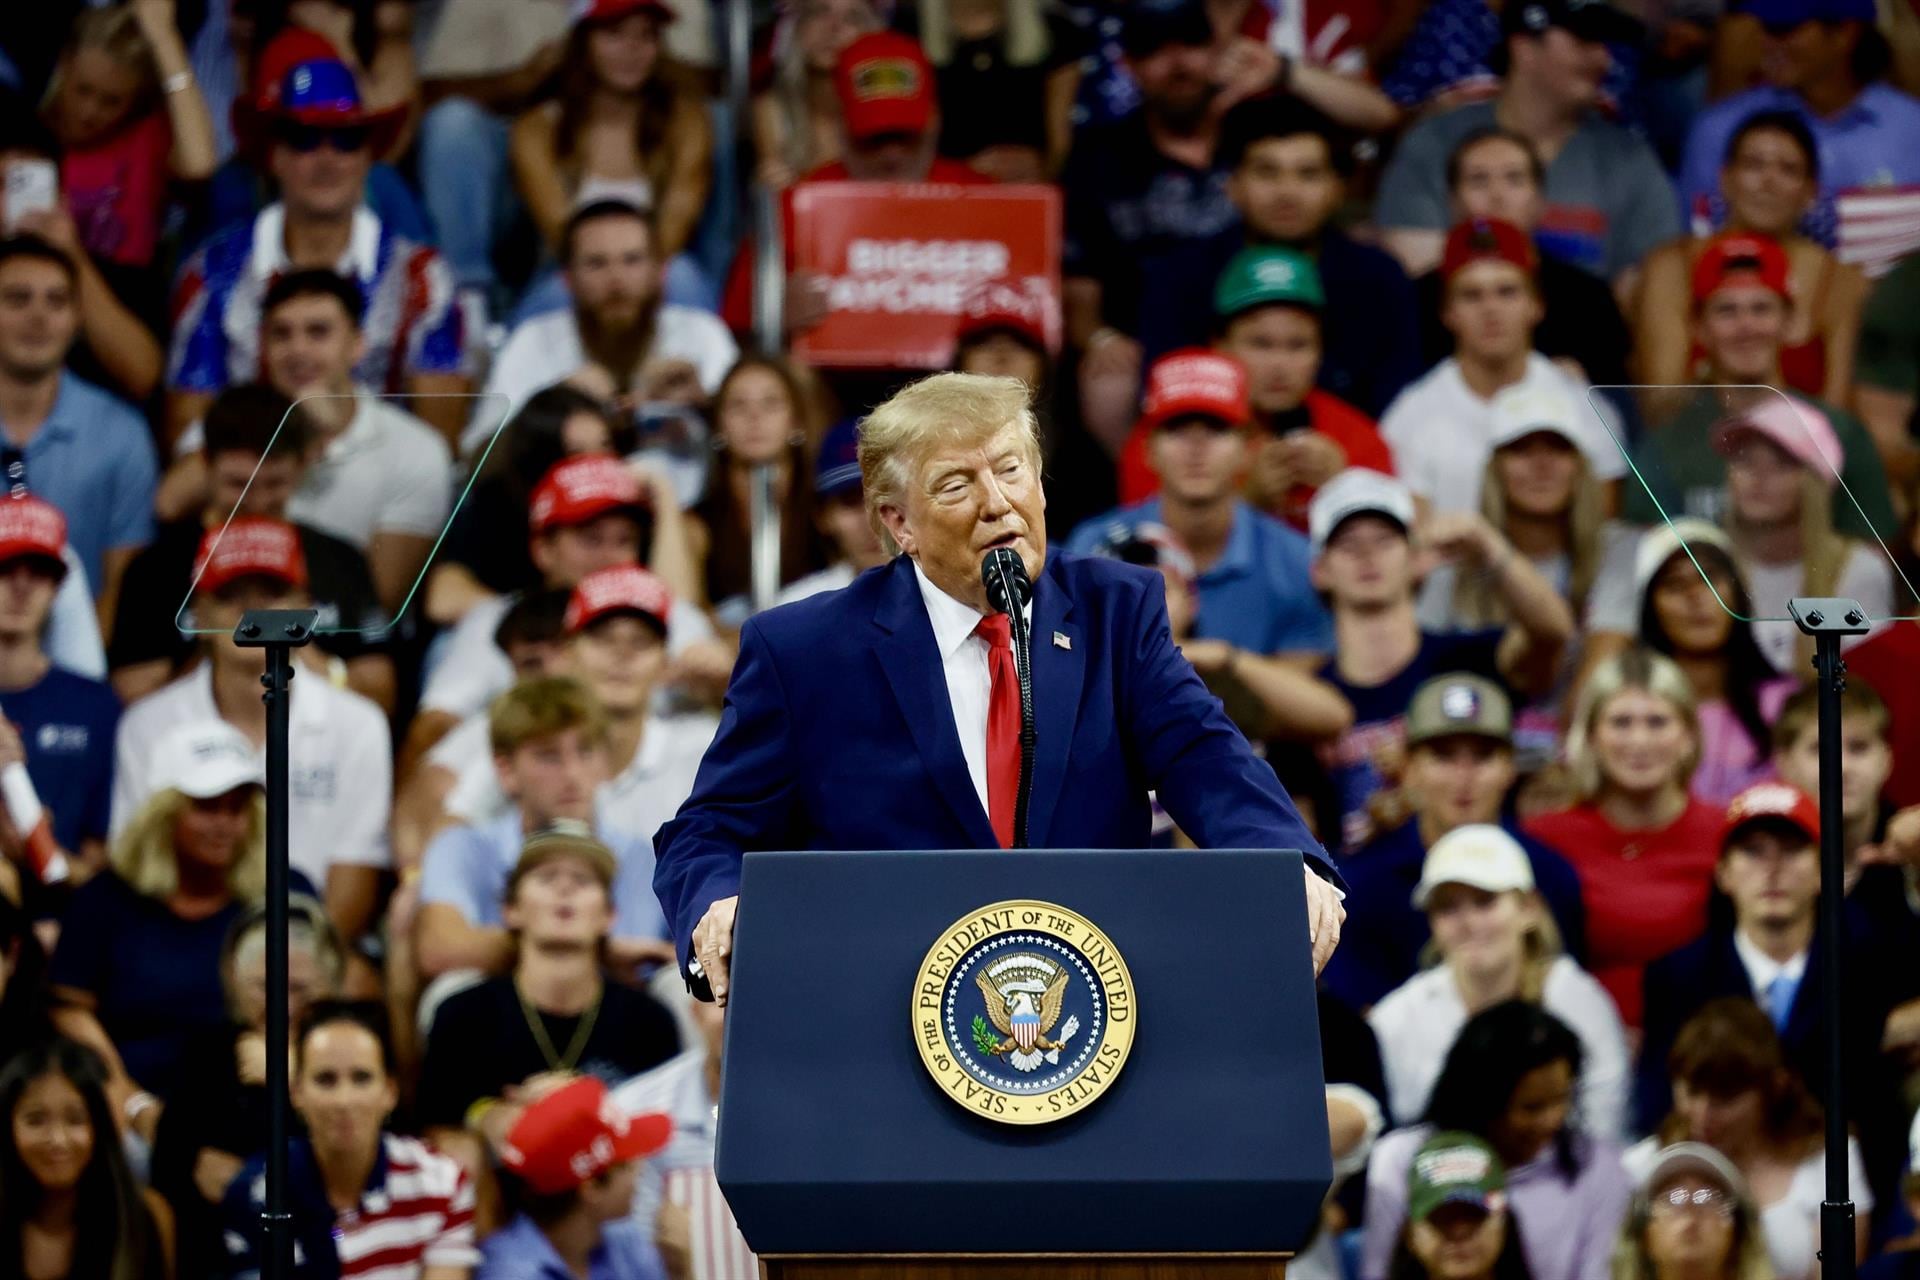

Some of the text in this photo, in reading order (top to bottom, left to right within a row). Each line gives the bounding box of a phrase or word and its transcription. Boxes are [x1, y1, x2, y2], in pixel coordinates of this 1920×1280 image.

[849, 240, 1008, 275] BIGGER
[920, 910, 1129, 1114] SEAL OF THE PRESIDENT OF THE UNITED STATES
